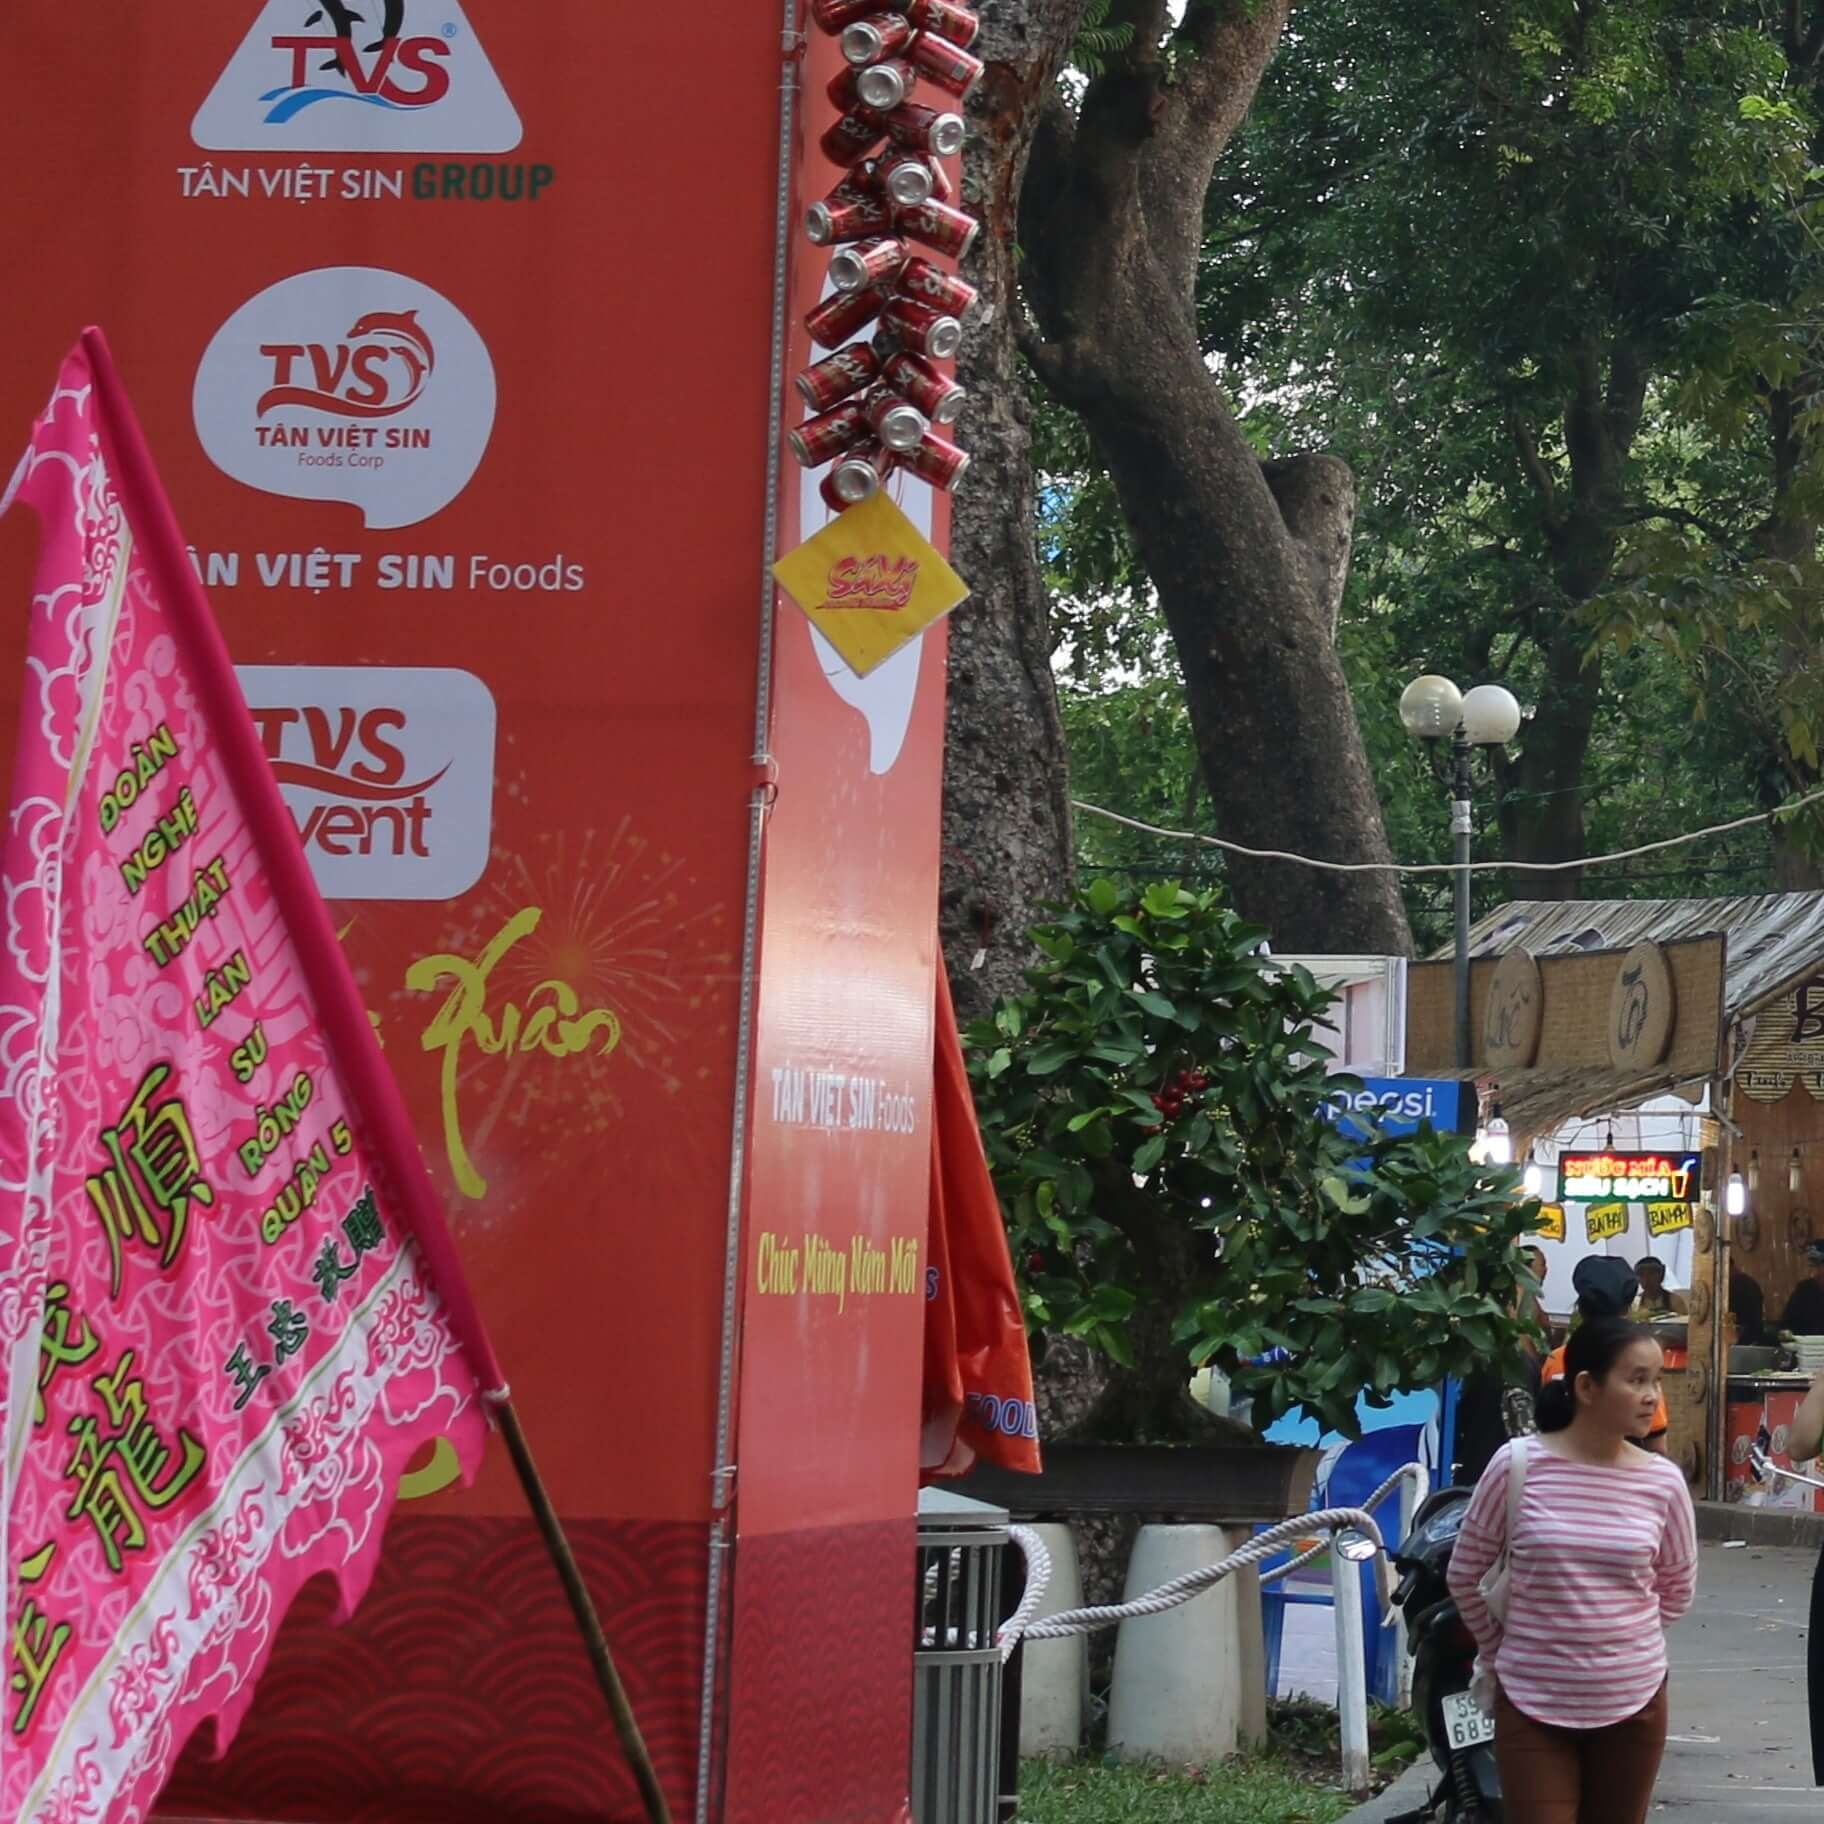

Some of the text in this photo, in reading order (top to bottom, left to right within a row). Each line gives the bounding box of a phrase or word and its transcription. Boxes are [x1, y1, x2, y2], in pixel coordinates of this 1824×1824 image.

[272, 36, 452, 106] TVS
[177, 162, 555, 204] TÂN VIỆT SIN GROUP
[260, 344, 389, 406] TVS
[255, 423, 430, 451] TÂN VIỆT SIN
[298, 453, 384, 470] Foods Corp
[185, 545, 584, 595] ÂN VIỆT SIN Foods
[285, 796, 432, 857] vent
[878, 1079, 915, 1135] Foods
[329, 1118, 352, 1155] 5
